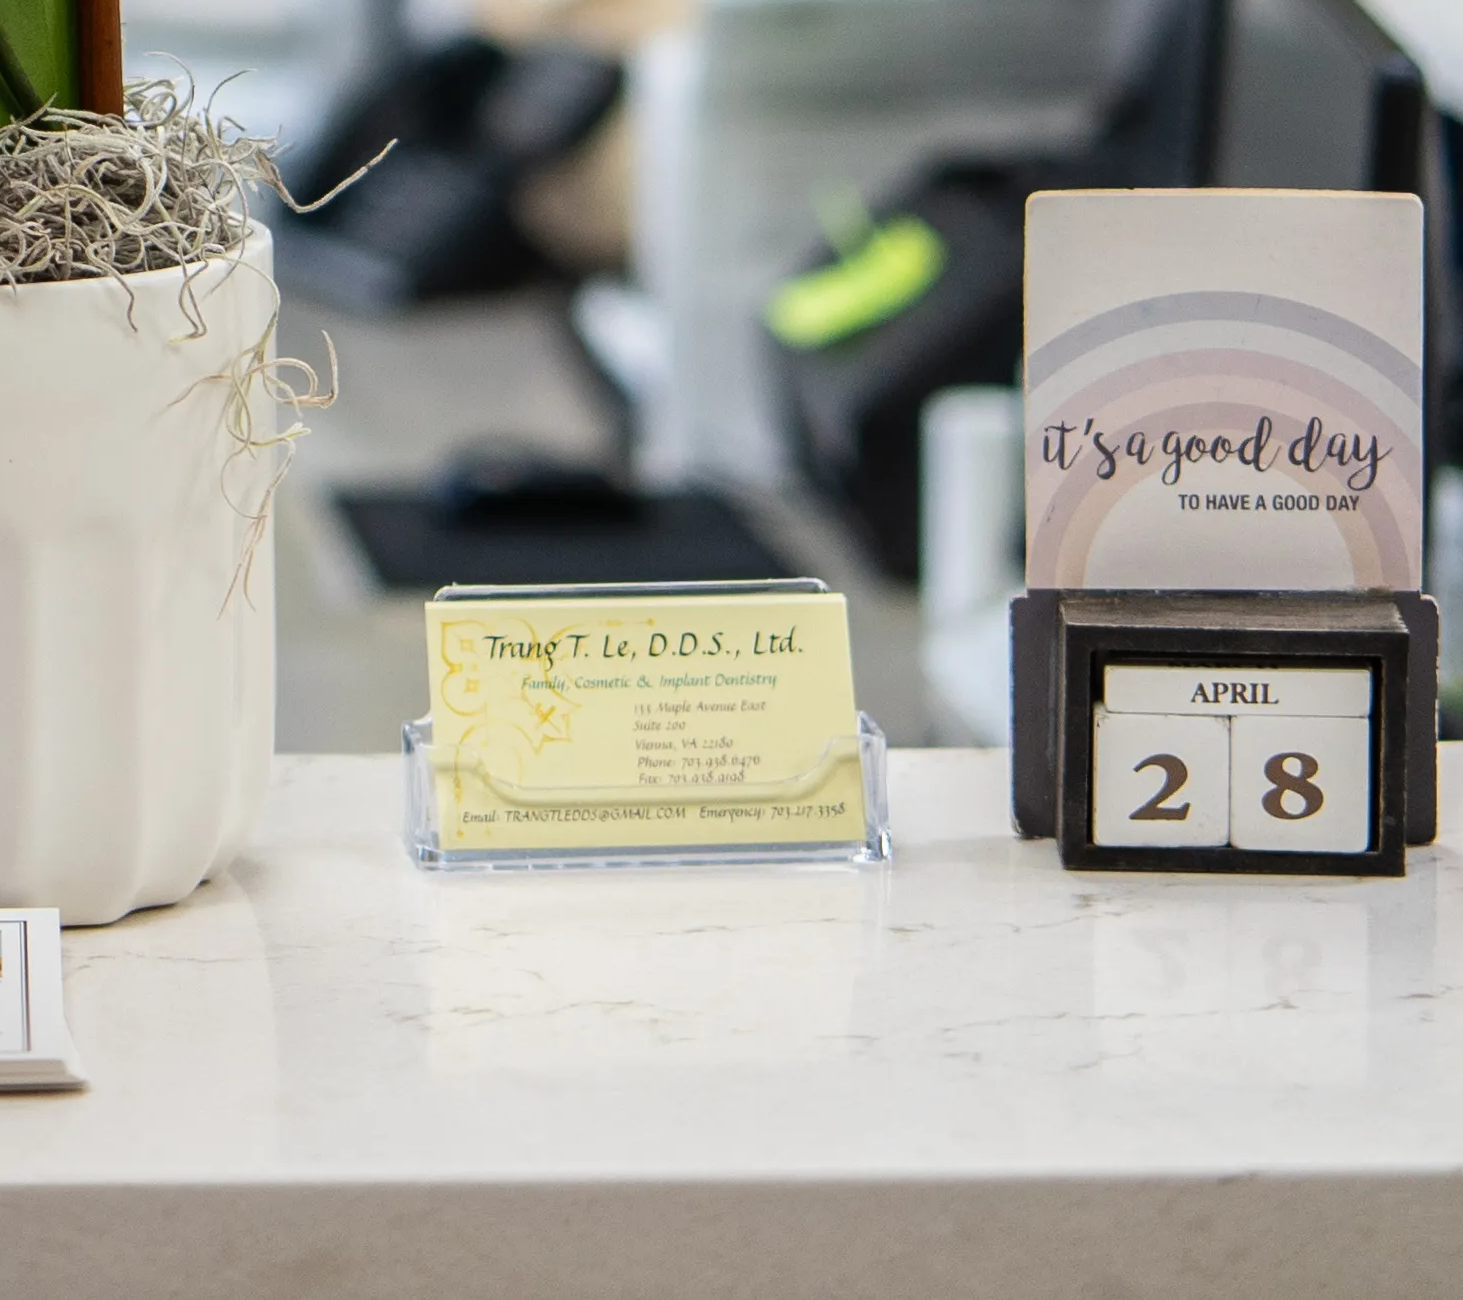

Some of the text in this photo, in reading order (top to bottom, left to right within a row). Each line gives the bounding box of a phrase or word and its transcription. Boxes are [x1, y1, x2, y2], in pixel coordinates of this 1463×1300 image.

[1043, 416, 1394, 492] it's a good day
[1178, 494, 1360, 511] TO HAVE A GOOD DAY
[482, 625, 803, 672] Trang T. Le, D.D.S., Ltd.
[521, 671, 778, 693] Family, Cosmetic & Implant Dentistry
[1190, 682, 1279, 704] APRIL
[657, 700, 692, 717] Maple
[696, 700, 737, 713] Avenue
[740, 699, 767, 712] East
[632, 719, 687, 732] Suite 200
[634, 736, 734, 751] Vienna, VA 22180
